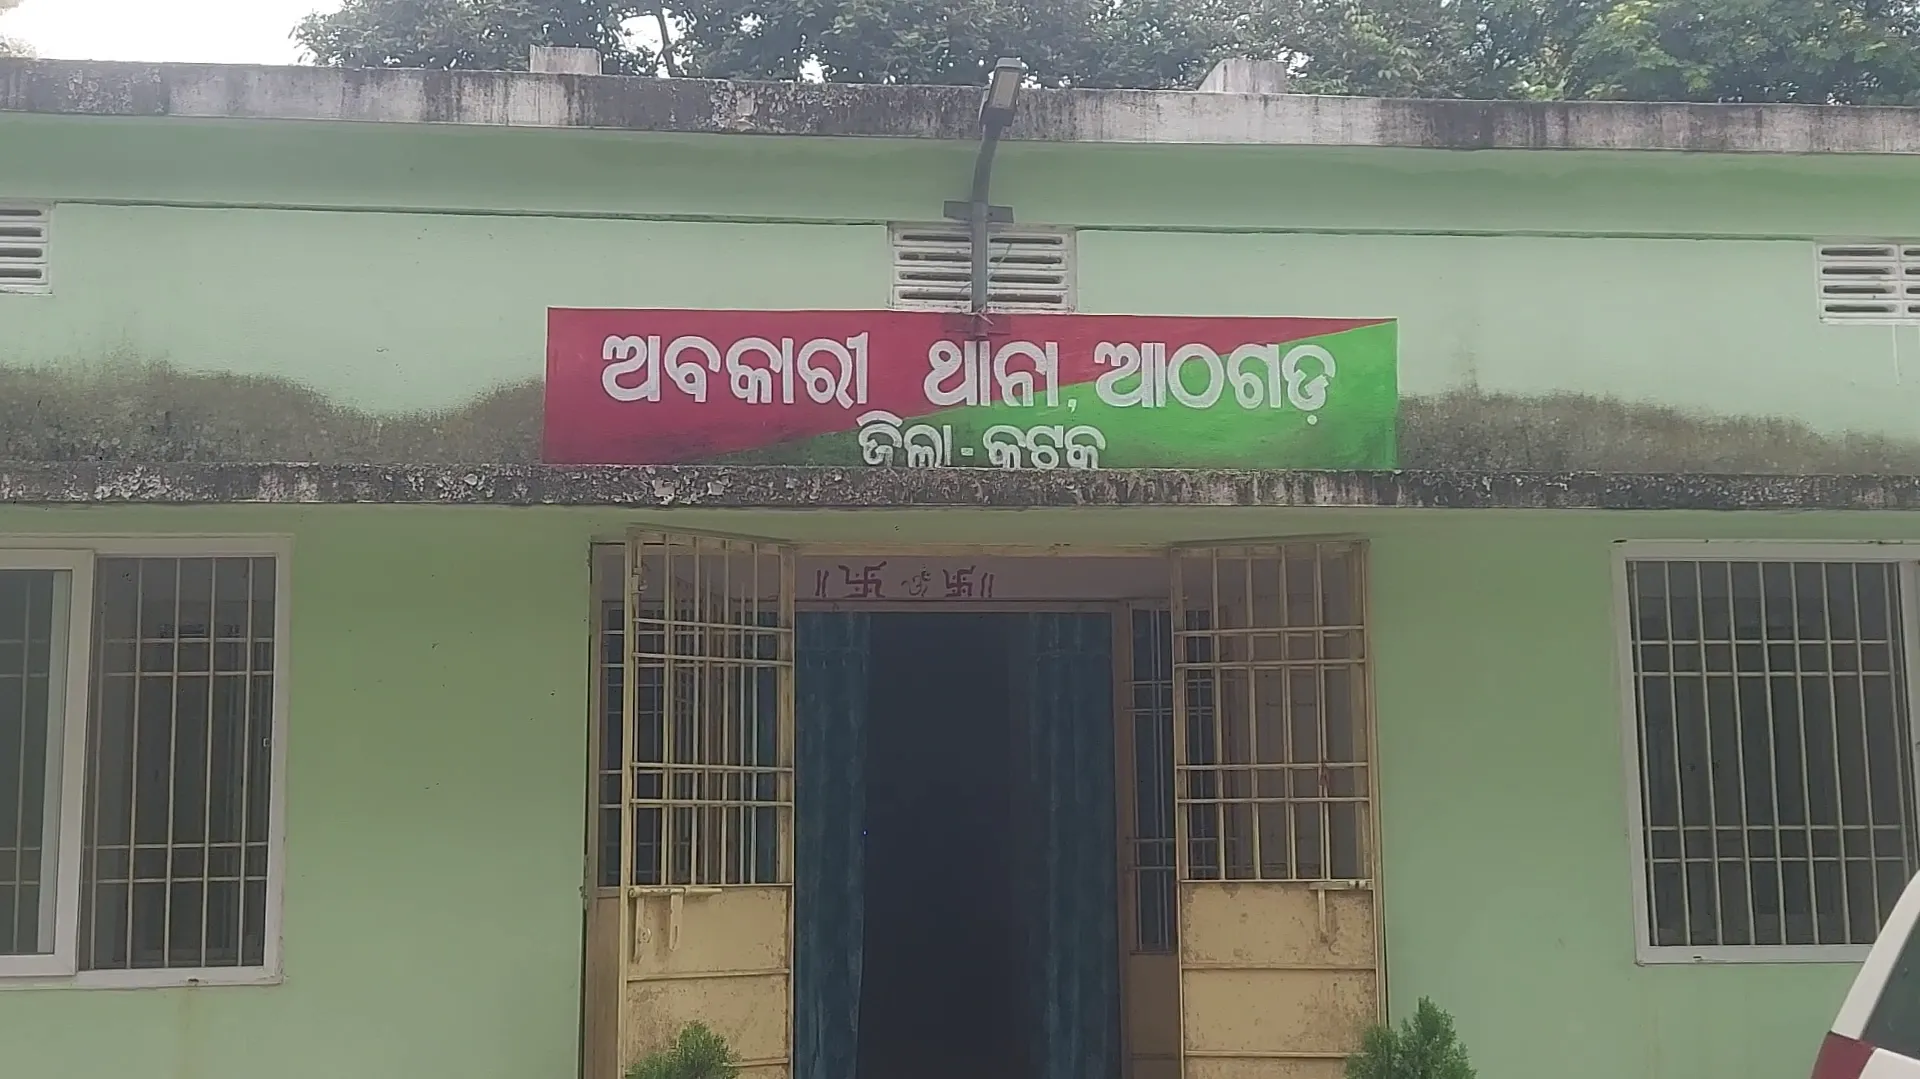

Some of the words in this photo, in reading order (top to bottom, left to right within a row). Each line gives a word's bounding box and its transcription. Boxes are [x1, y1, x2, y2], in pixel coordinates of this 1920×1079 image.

[602, 332, 869, 410] ଅବକାରୀ
[923, 339, 1078, 413] ଥାନା,
[1094, 341, 1337, 426] ଆଠଗଡ଼
[982, 425, 1106, 470] କଟକ
